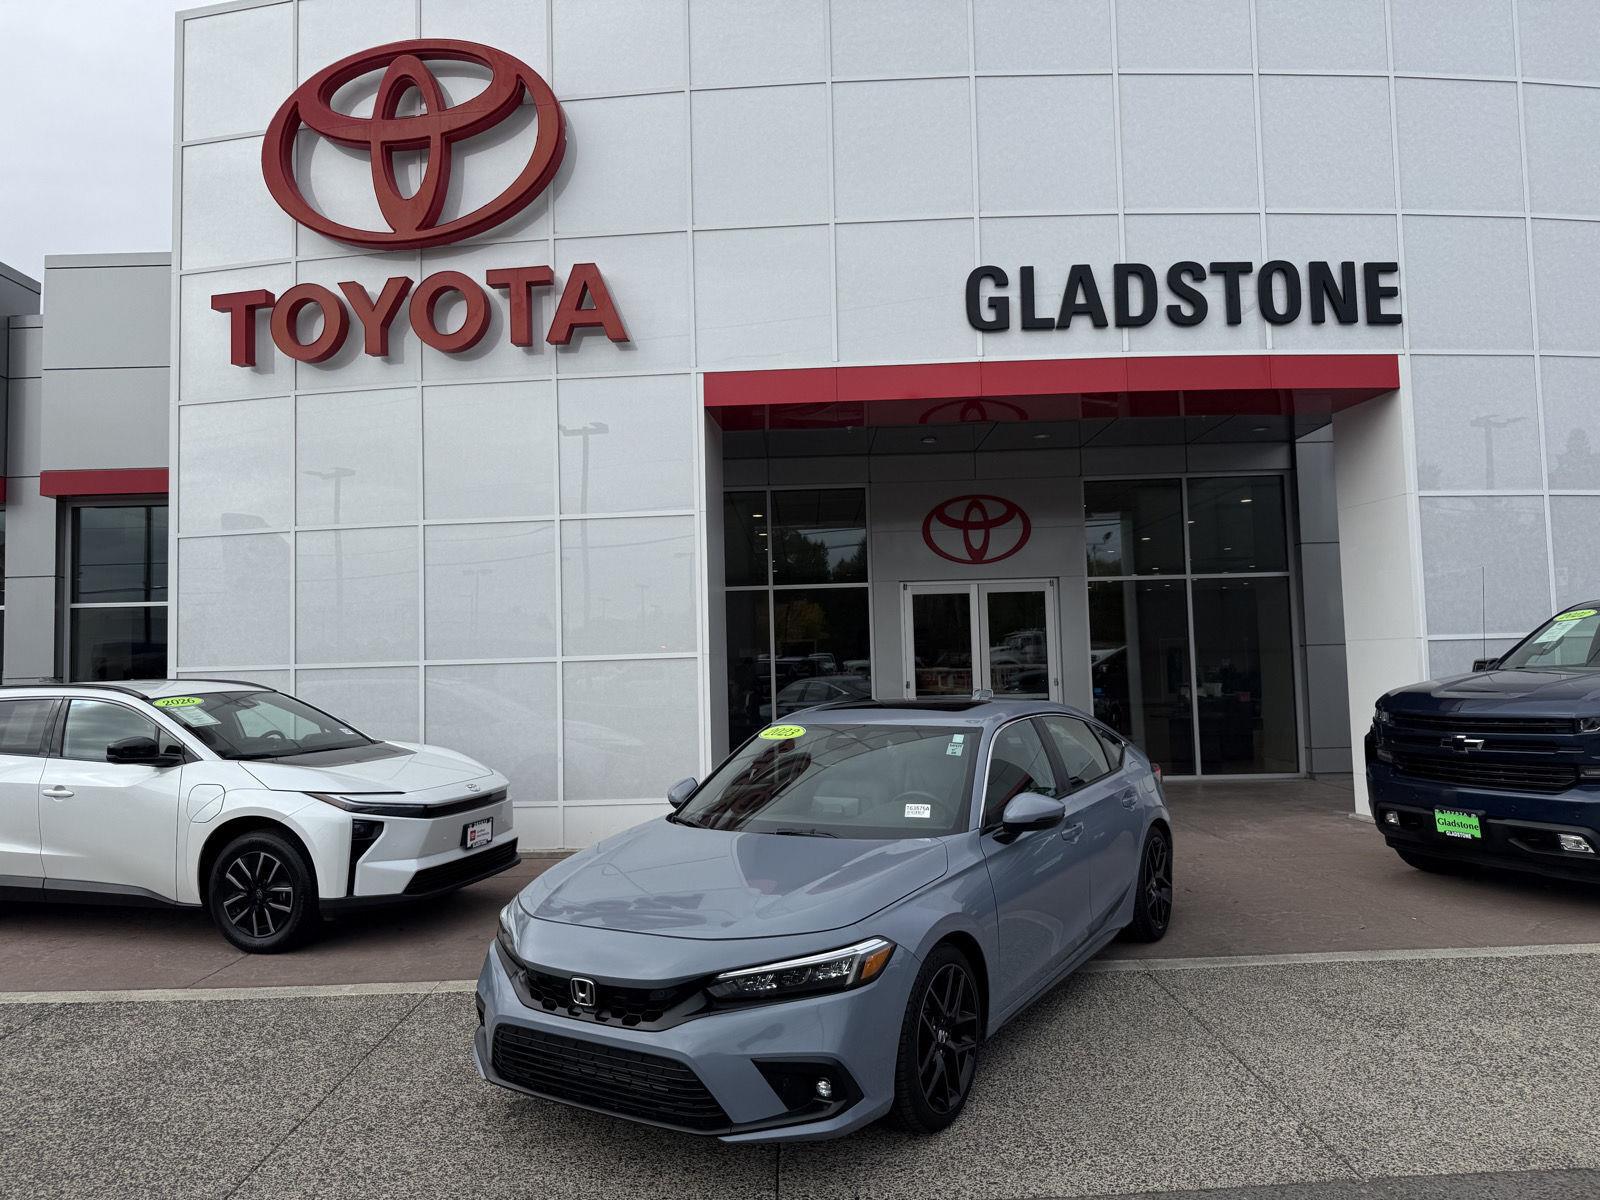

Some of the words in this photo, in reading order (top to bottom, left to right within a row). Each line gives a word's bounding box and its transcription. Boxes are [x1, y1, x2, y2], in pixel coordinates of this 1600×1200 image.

[965, 260, 1402, 332] GLADSTONE
[211, 263, 631, 367] TOYOTA
[162, 697, 195, 706] 2026
[1437, 816, 1480, 831] Gladstone
[1445, 830, 1472, 840] GLADSTONE
